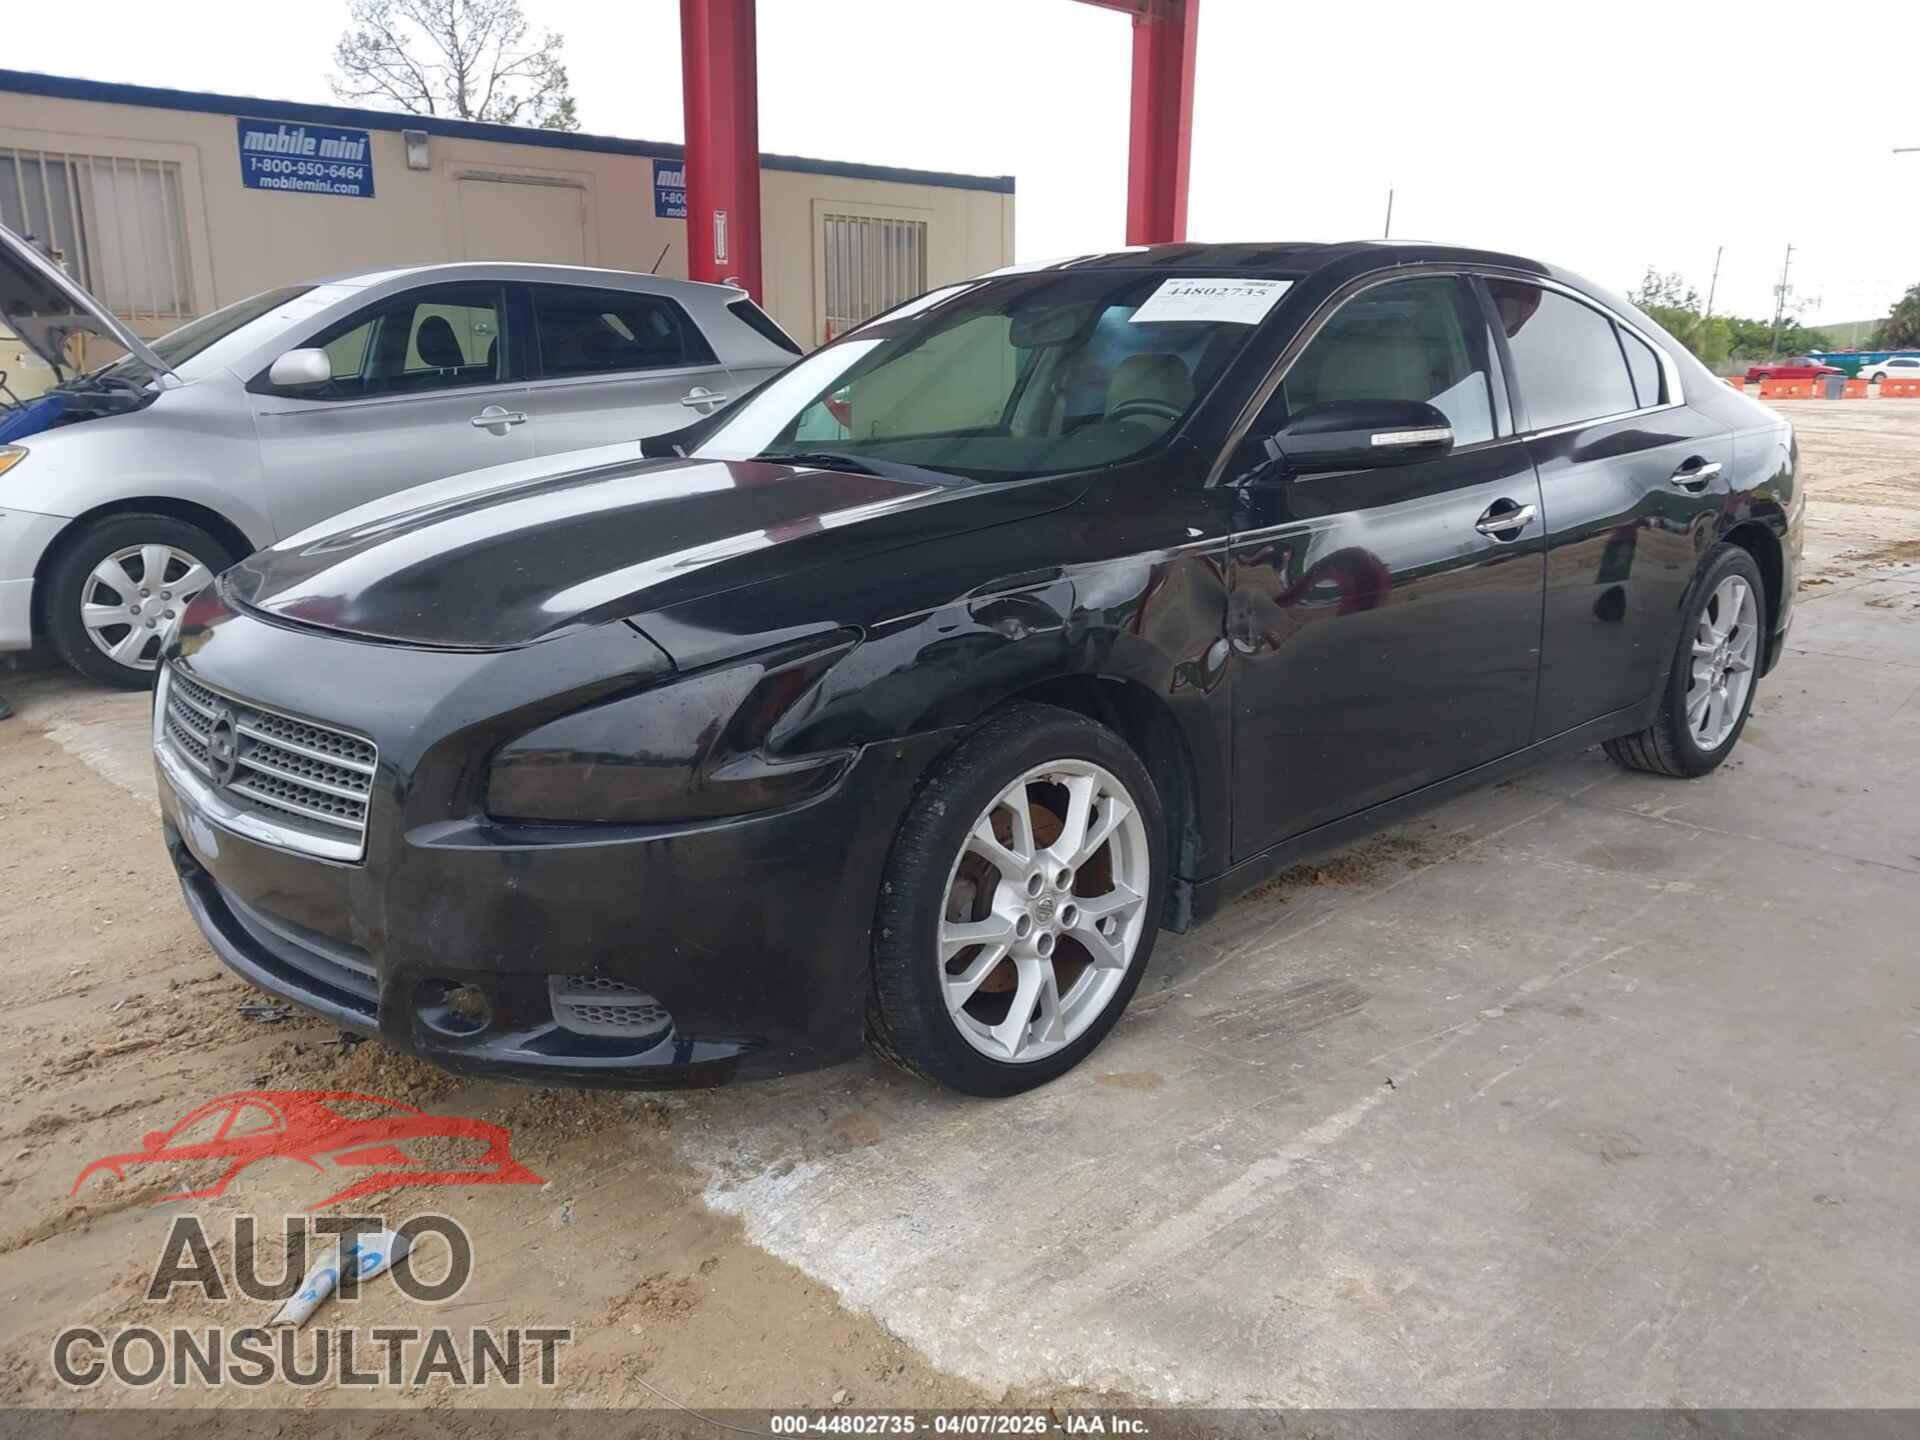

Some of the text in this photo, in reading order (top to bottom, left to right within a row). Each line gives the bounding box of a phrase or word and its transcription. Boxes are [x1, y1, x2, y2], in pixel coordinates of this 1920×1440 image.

[243, 125, 369, 160] mobile mini
[250, 158, 363, 180] 1-800-950-6464
[259, 177, 360, 194] mobilemini.com
